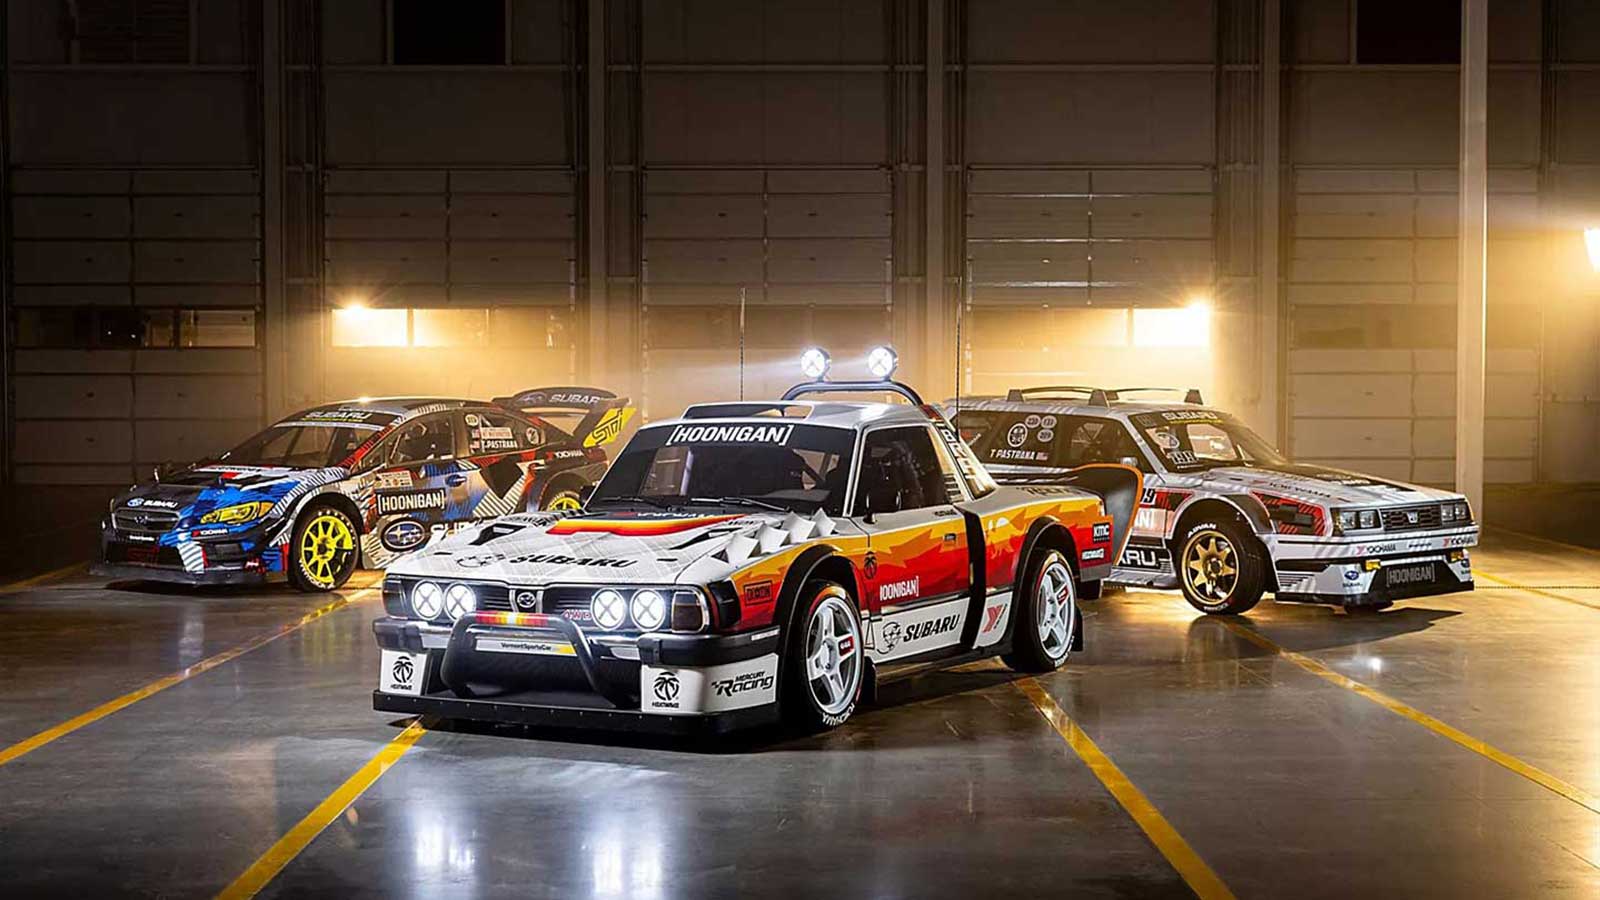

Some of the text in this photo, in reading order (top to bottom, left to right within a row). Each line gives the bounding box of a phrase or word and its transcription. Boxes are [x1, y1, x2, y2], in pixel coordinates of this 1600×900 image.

[549, 394, 603, 404] SUBAR
[665, 425, 794, 446] [HOONIGAN]
[378, 489, 444, 515] [HOONIGAN]
[903, 614, 961, 643] SUBARU
[735, 671, 765, 682] MERCURY
[716, 677, 774, 697] Racing
